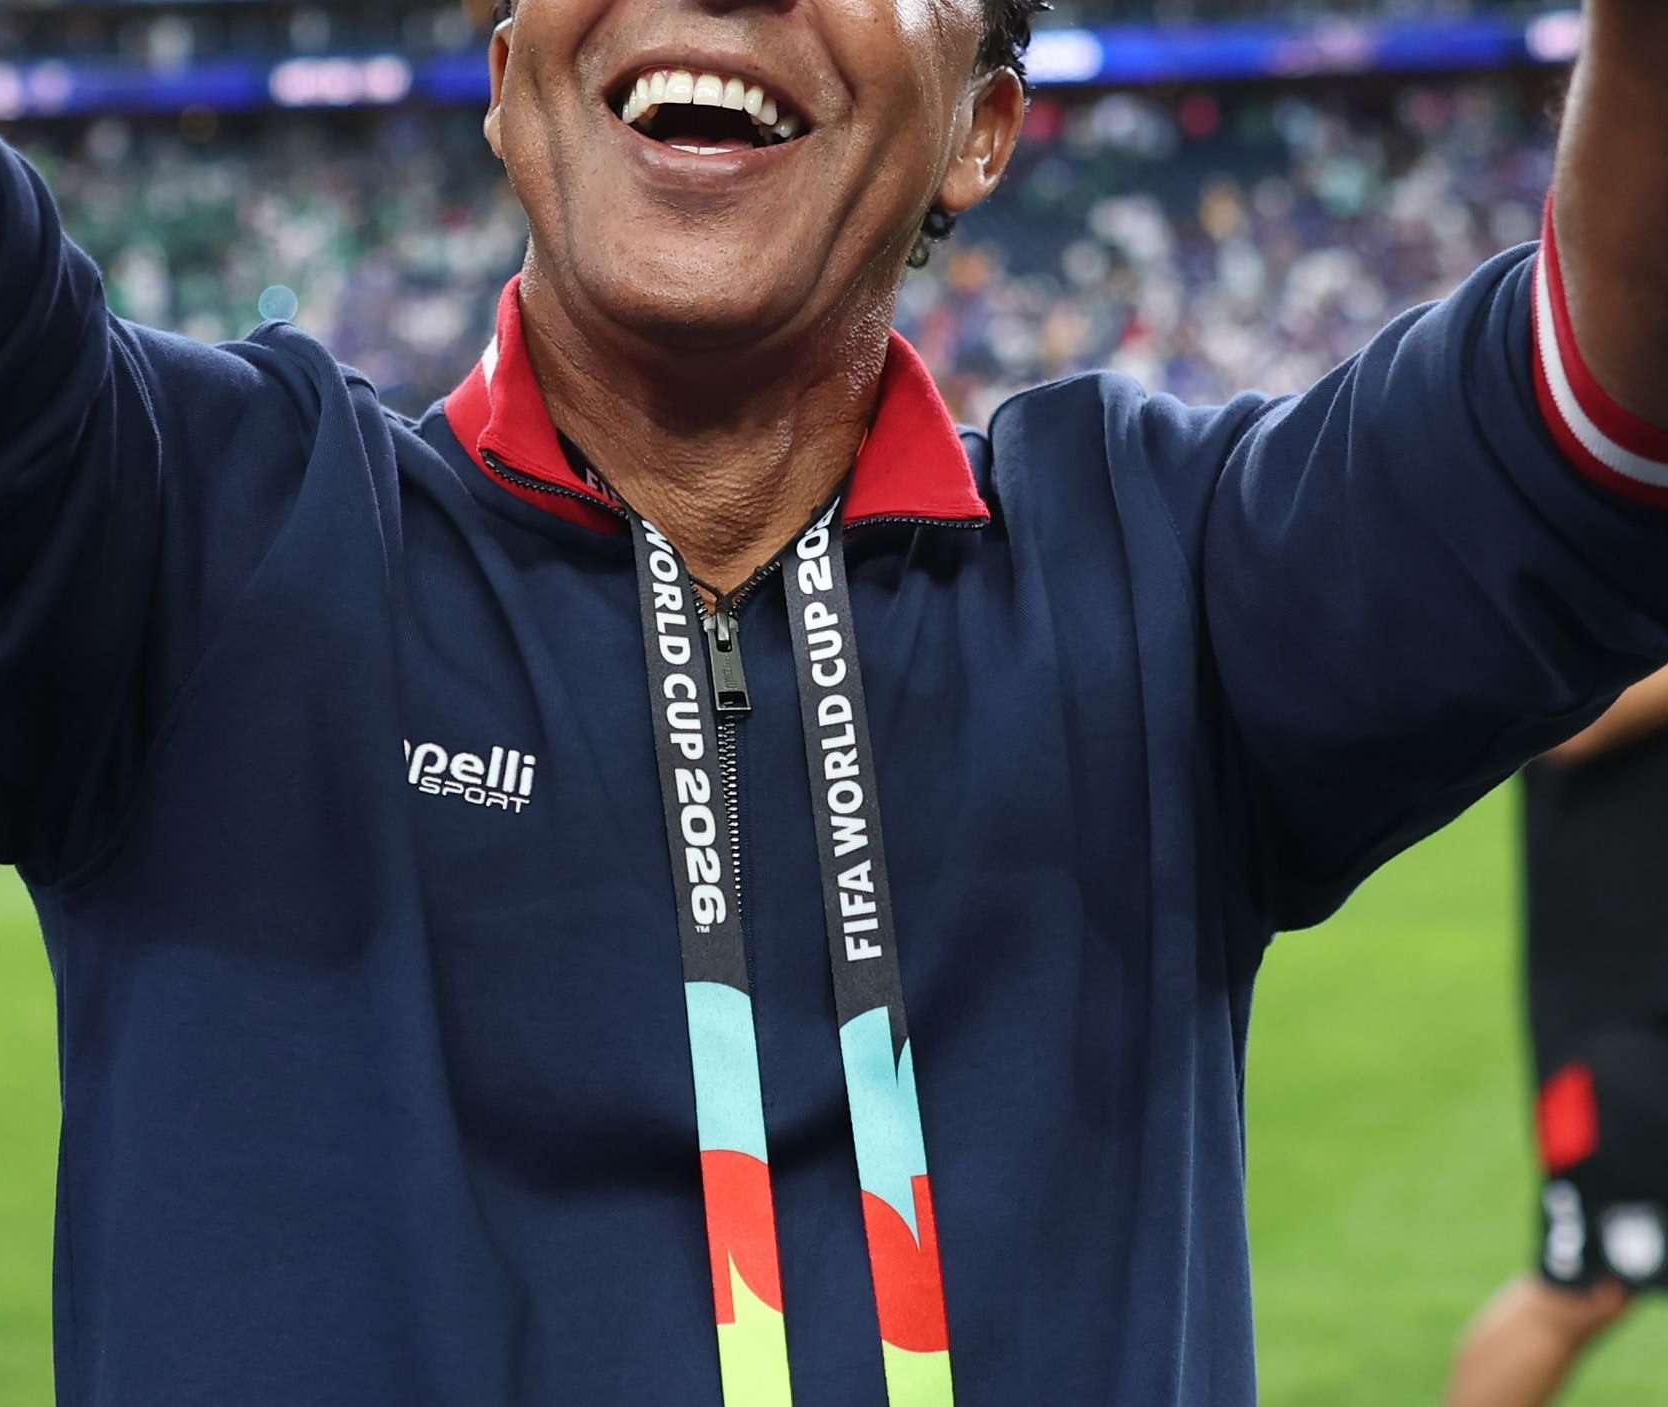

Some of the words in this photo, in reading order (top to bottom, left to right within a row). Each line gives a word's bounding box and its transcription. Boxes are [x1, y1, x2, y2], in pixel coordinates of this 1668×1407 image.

[641, 519, 691, 666] WORLD
[803, 601, 847, 687] CUP
[663, 673, 704, 761] CUP
[403, 739, 536, 797] pelli
[418, 776, 530, 814] SPORT
[817, 694, 869, 858] WORLD
[837, 859, 883, 962] FIFA
